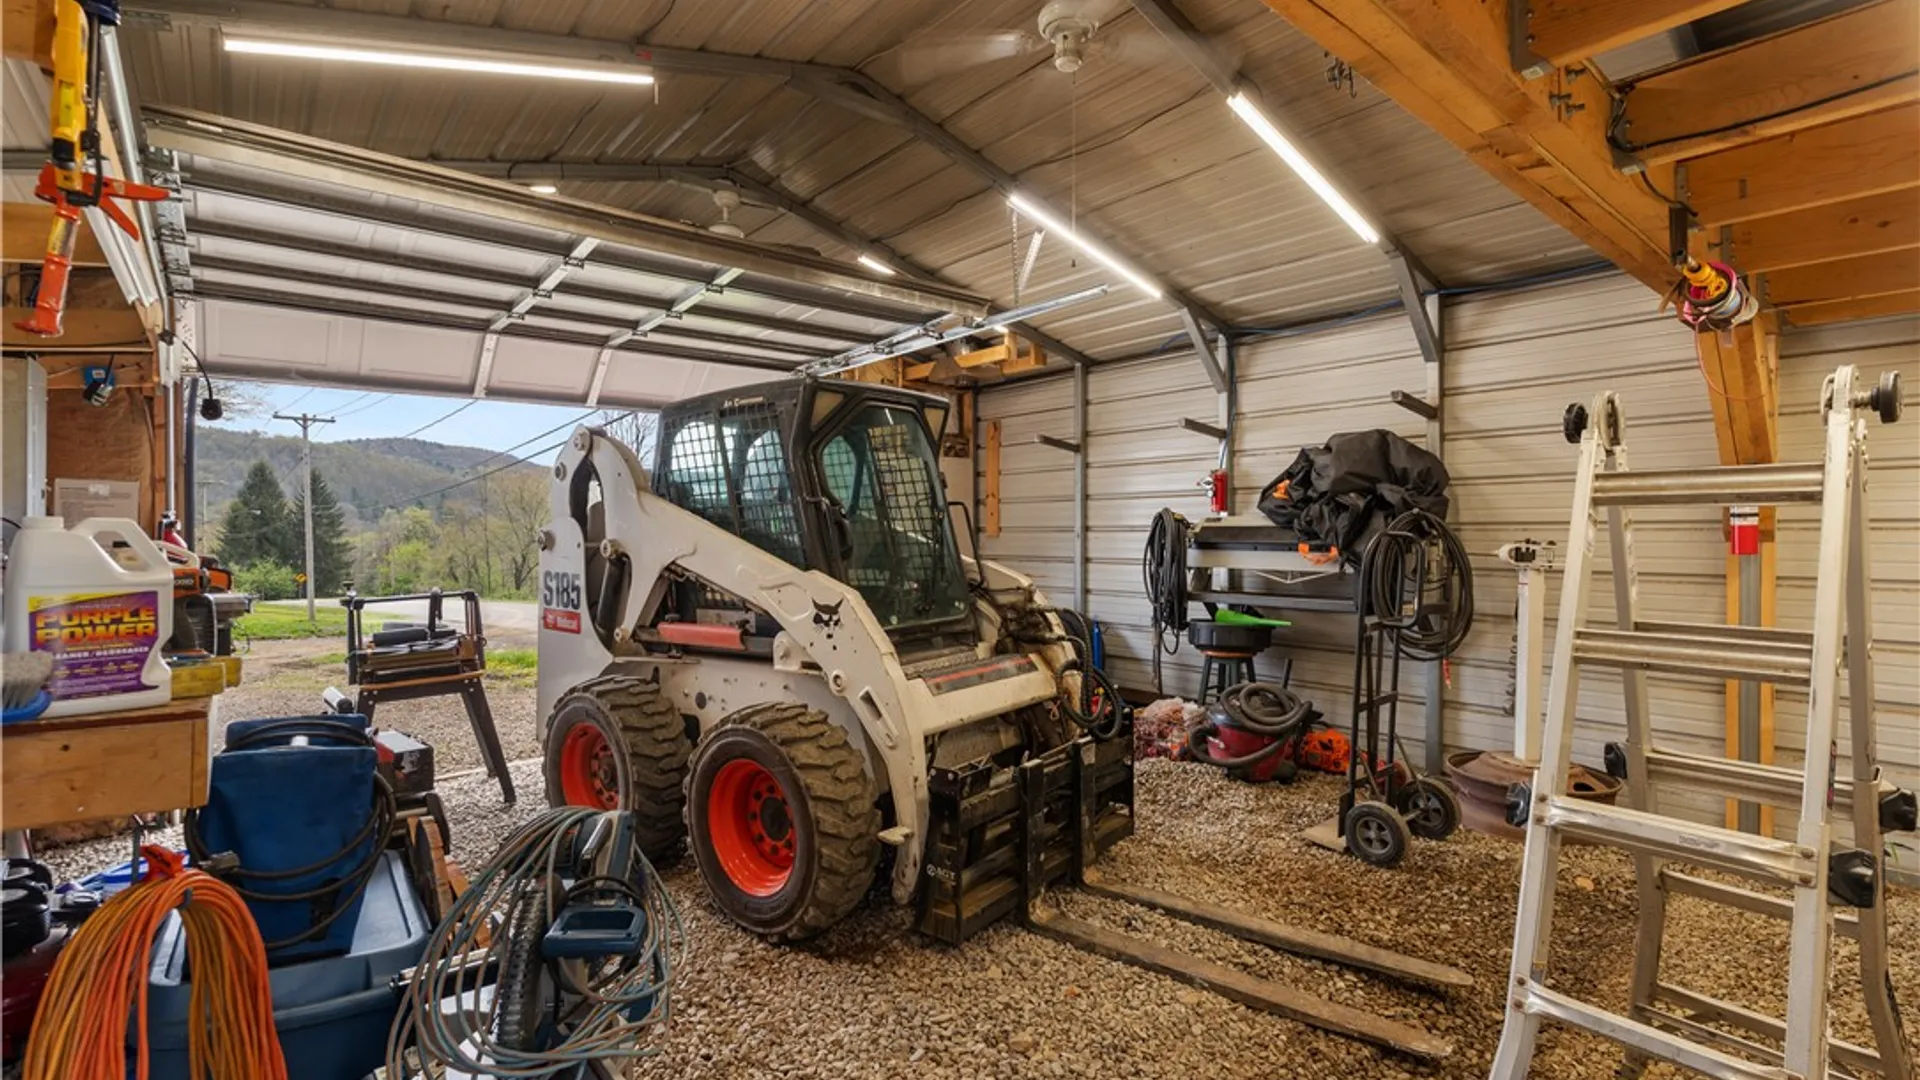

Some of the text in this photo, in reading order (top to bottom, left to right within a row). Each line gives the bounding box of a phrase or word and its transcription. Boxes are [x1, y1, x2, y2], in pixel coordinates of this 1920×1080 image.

[543, 570, 581, 610] S185
[36, 608, 155, 628] PURPLE
[36, 622, 155, 647] POWER
